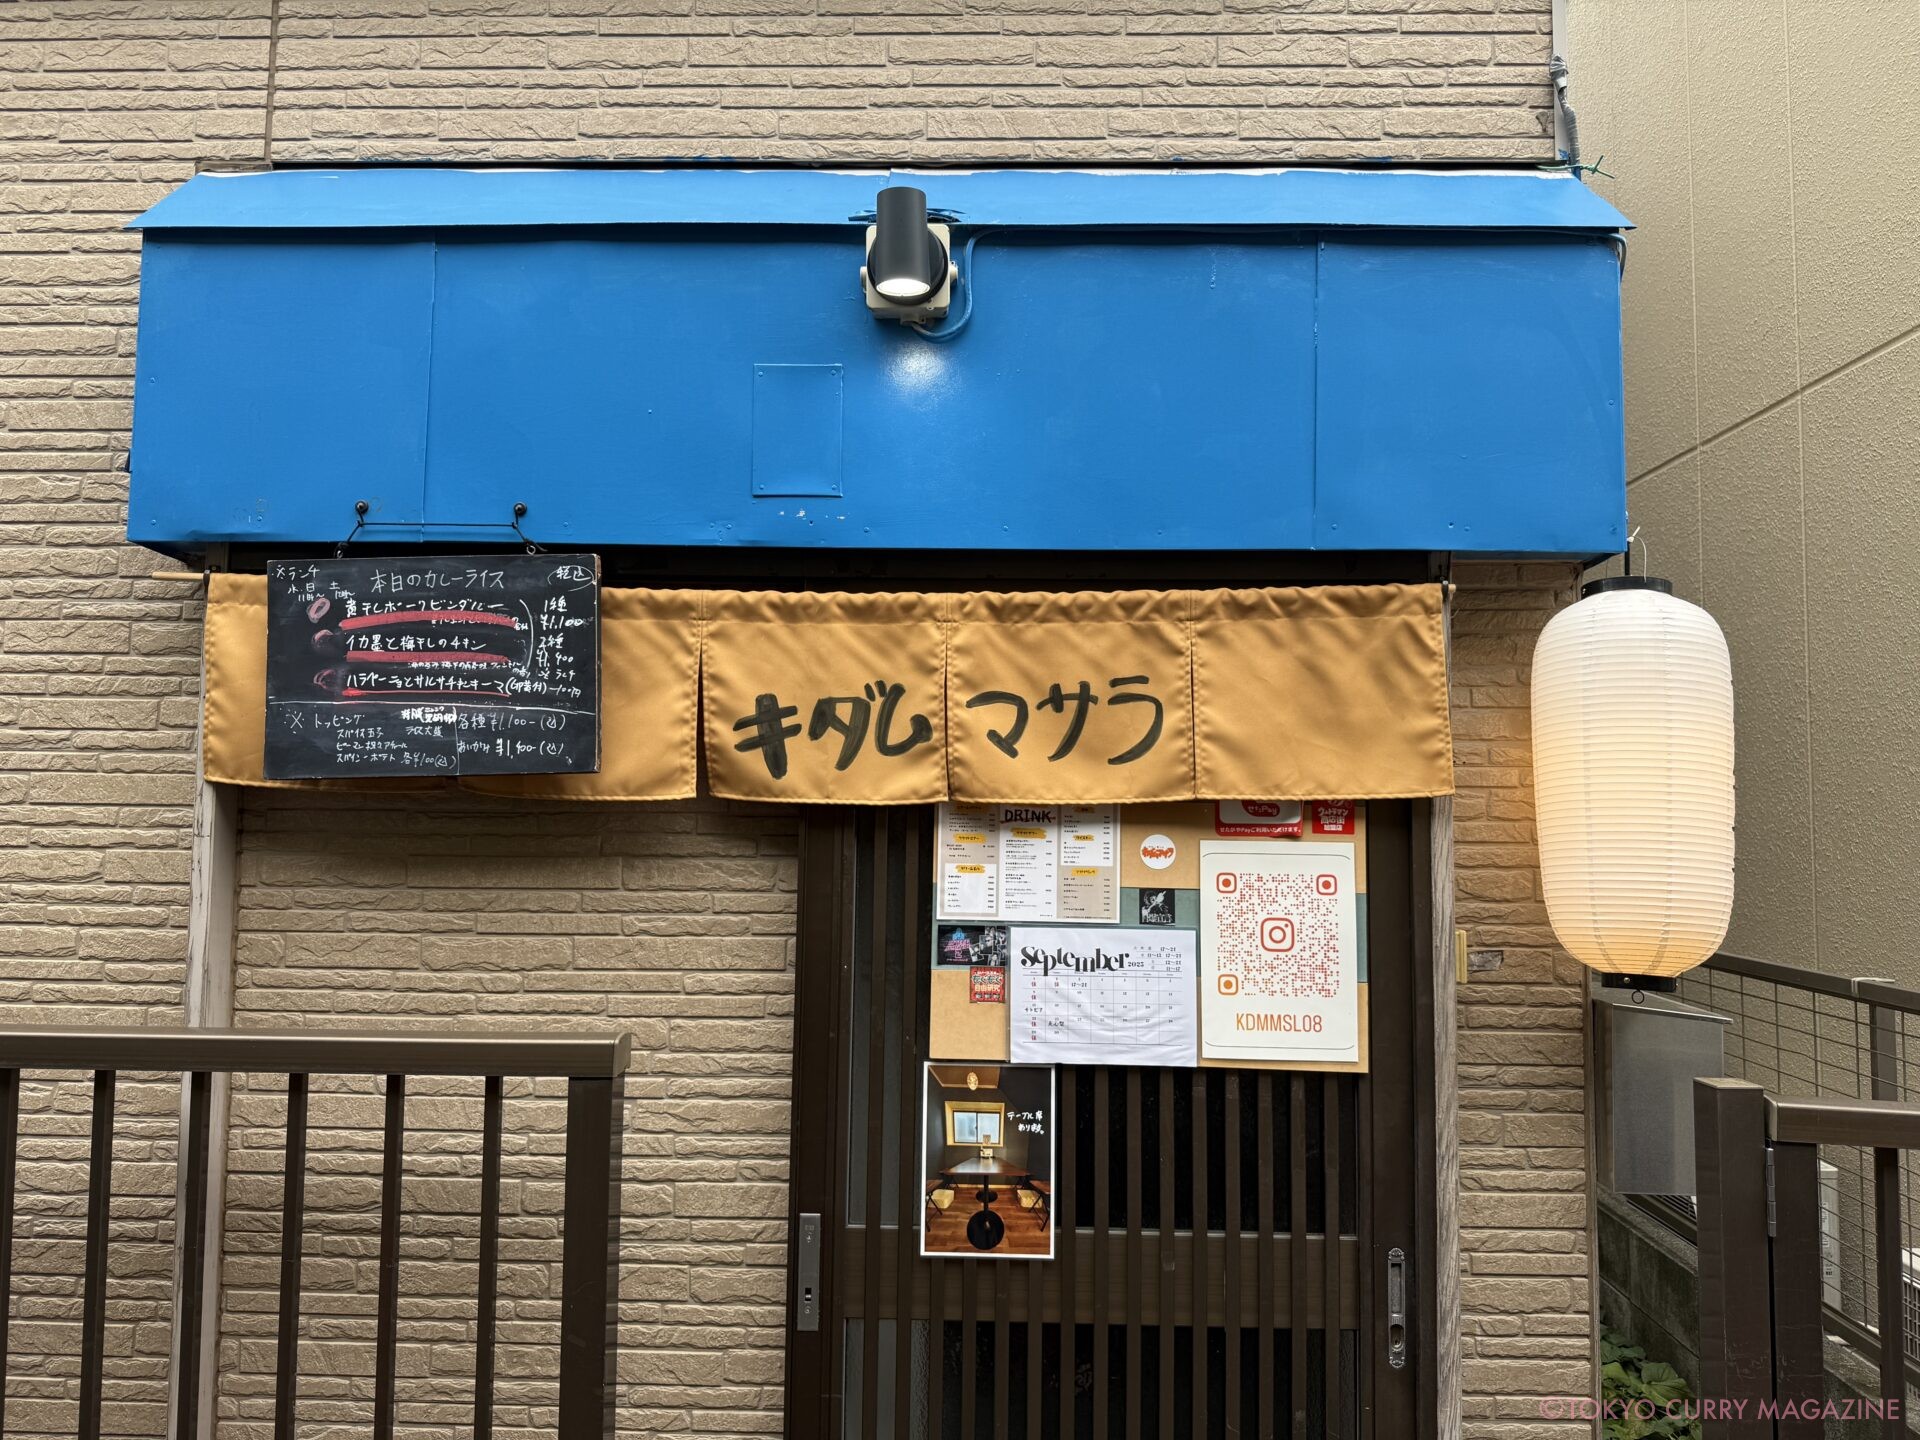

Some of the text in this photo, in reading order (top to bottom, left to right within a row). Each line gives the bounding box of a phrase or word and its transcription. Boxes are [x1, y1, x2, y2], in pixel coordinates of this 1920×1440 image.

[329, 581, 341, 590] 土
[370, 569, 504, 593] 本日のカレーライス
[315, 713, 365, 729] トッピング
[966, 675, 1164, 766] マサラ
[1004, 808, 1052, 824] DRINK
[1021, 946, 1129, 976] September
[1236, 1013, 1322, 1033] KDMMSL08
